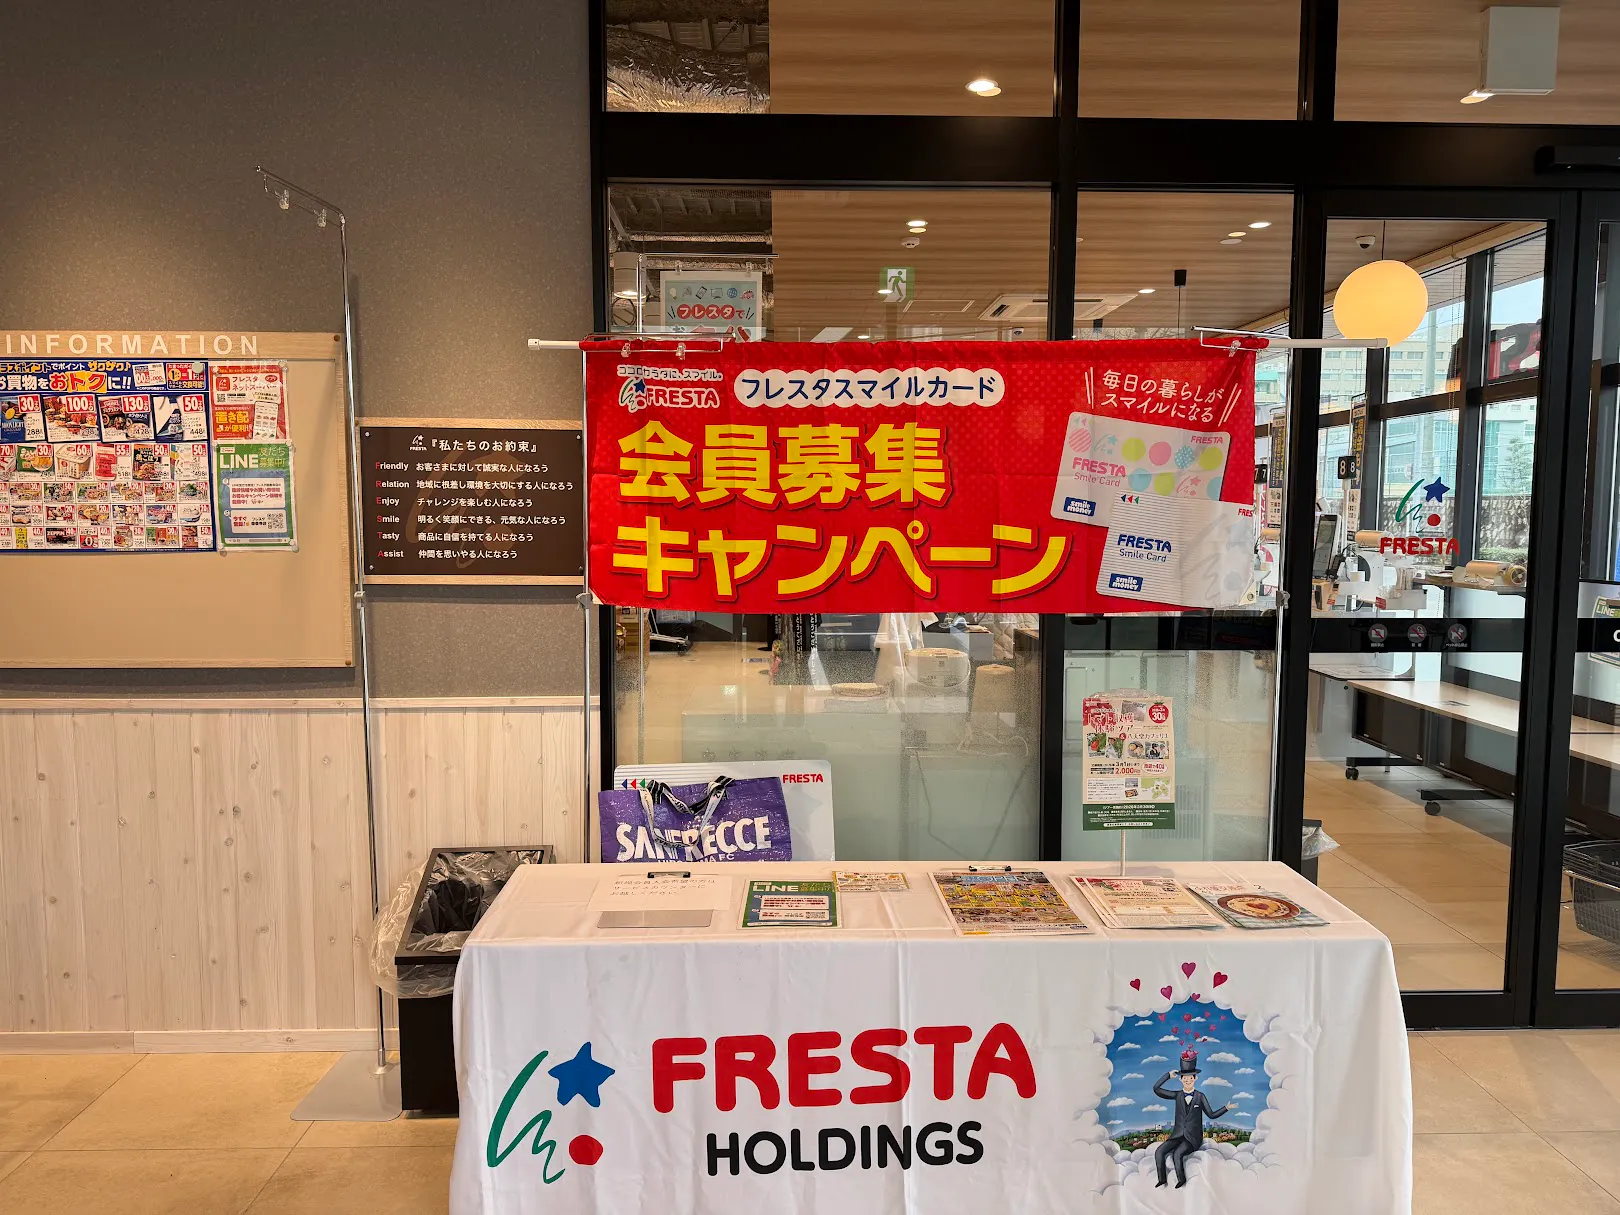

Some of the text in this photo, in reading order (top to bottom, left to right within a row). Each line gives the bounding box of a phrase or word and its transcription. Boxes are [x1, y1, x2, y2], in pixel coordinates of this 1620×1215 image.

[677, 304, 746, 320] フレスタで
[6, 334, 258, 355] INFORMATION
[618, 366, 723, 380] ココロカラダに、スマイル。
[741, 374, 996, 403] フレスタスマイルカード
[1102, 369, 1224, 404] 毎日の暮らしが
[20, 396, 34, 411] 30
[67, 397, 88, 411] 100
[124, 396, 143, 411] 130
[184, 396, 198, 411] 50
[647, 387, 720, 408] FRESTA
[1101, 392, 1215, 423] スマイルになる
[216, 411, 249, 423] 置き配
[431, 438, 538, 453] 『私たちのお約束』
[1190, 435, 1224, 445] FRESTA
[259, 447, 286, 456] 友だち
[219, 453, 259, 469] LINE
[375, 462, 549, 473] Friendly お客さまに対して誠実な人になろう
[617, 419, 948, 505] 会員募集
[1072, 456, 1127, 478] FRESTA
[1339, 459, 1356, 475] 8 8
[1073, 472, 1121, 487] Smile Card
[1262, 468, 1267, 479] 7
[375, 480, 410, 489] Relation
[376, 497, 533, 508] Enjoy チャレンジを楽しむ人になろう
[1070, 499, 1091, 510] smile
[1067, 505, 1092, 515] money
[377, 515, 566, 525] Smile 明るく笑顔にできる、元気な人になろう
[377, 532, 534, 542] Tasty 商品に自信を持てる人になろう
[1117, 533, 1172, 553] FRESTA
[1379, 537, 1461, 556] FRESTA
[377, 549, 518, 559] Assist 仲間を思いやる人になろう
[612, 515, 1066, 597] キャンペーン
[1119, 548, 1167, 562] Smile Card
[1112, 581, 1138, 591] money
[1115, 575, 1138, 586] smile
[1596, 604, 1616, 617] LINE
[782, 773, 824, 784] FRESTA
[752, 884, 799, 893] LINE
[651, 1022, 1038, 1114] FRESTA
[706, 1120, 987, 1177] HOLDINGS
